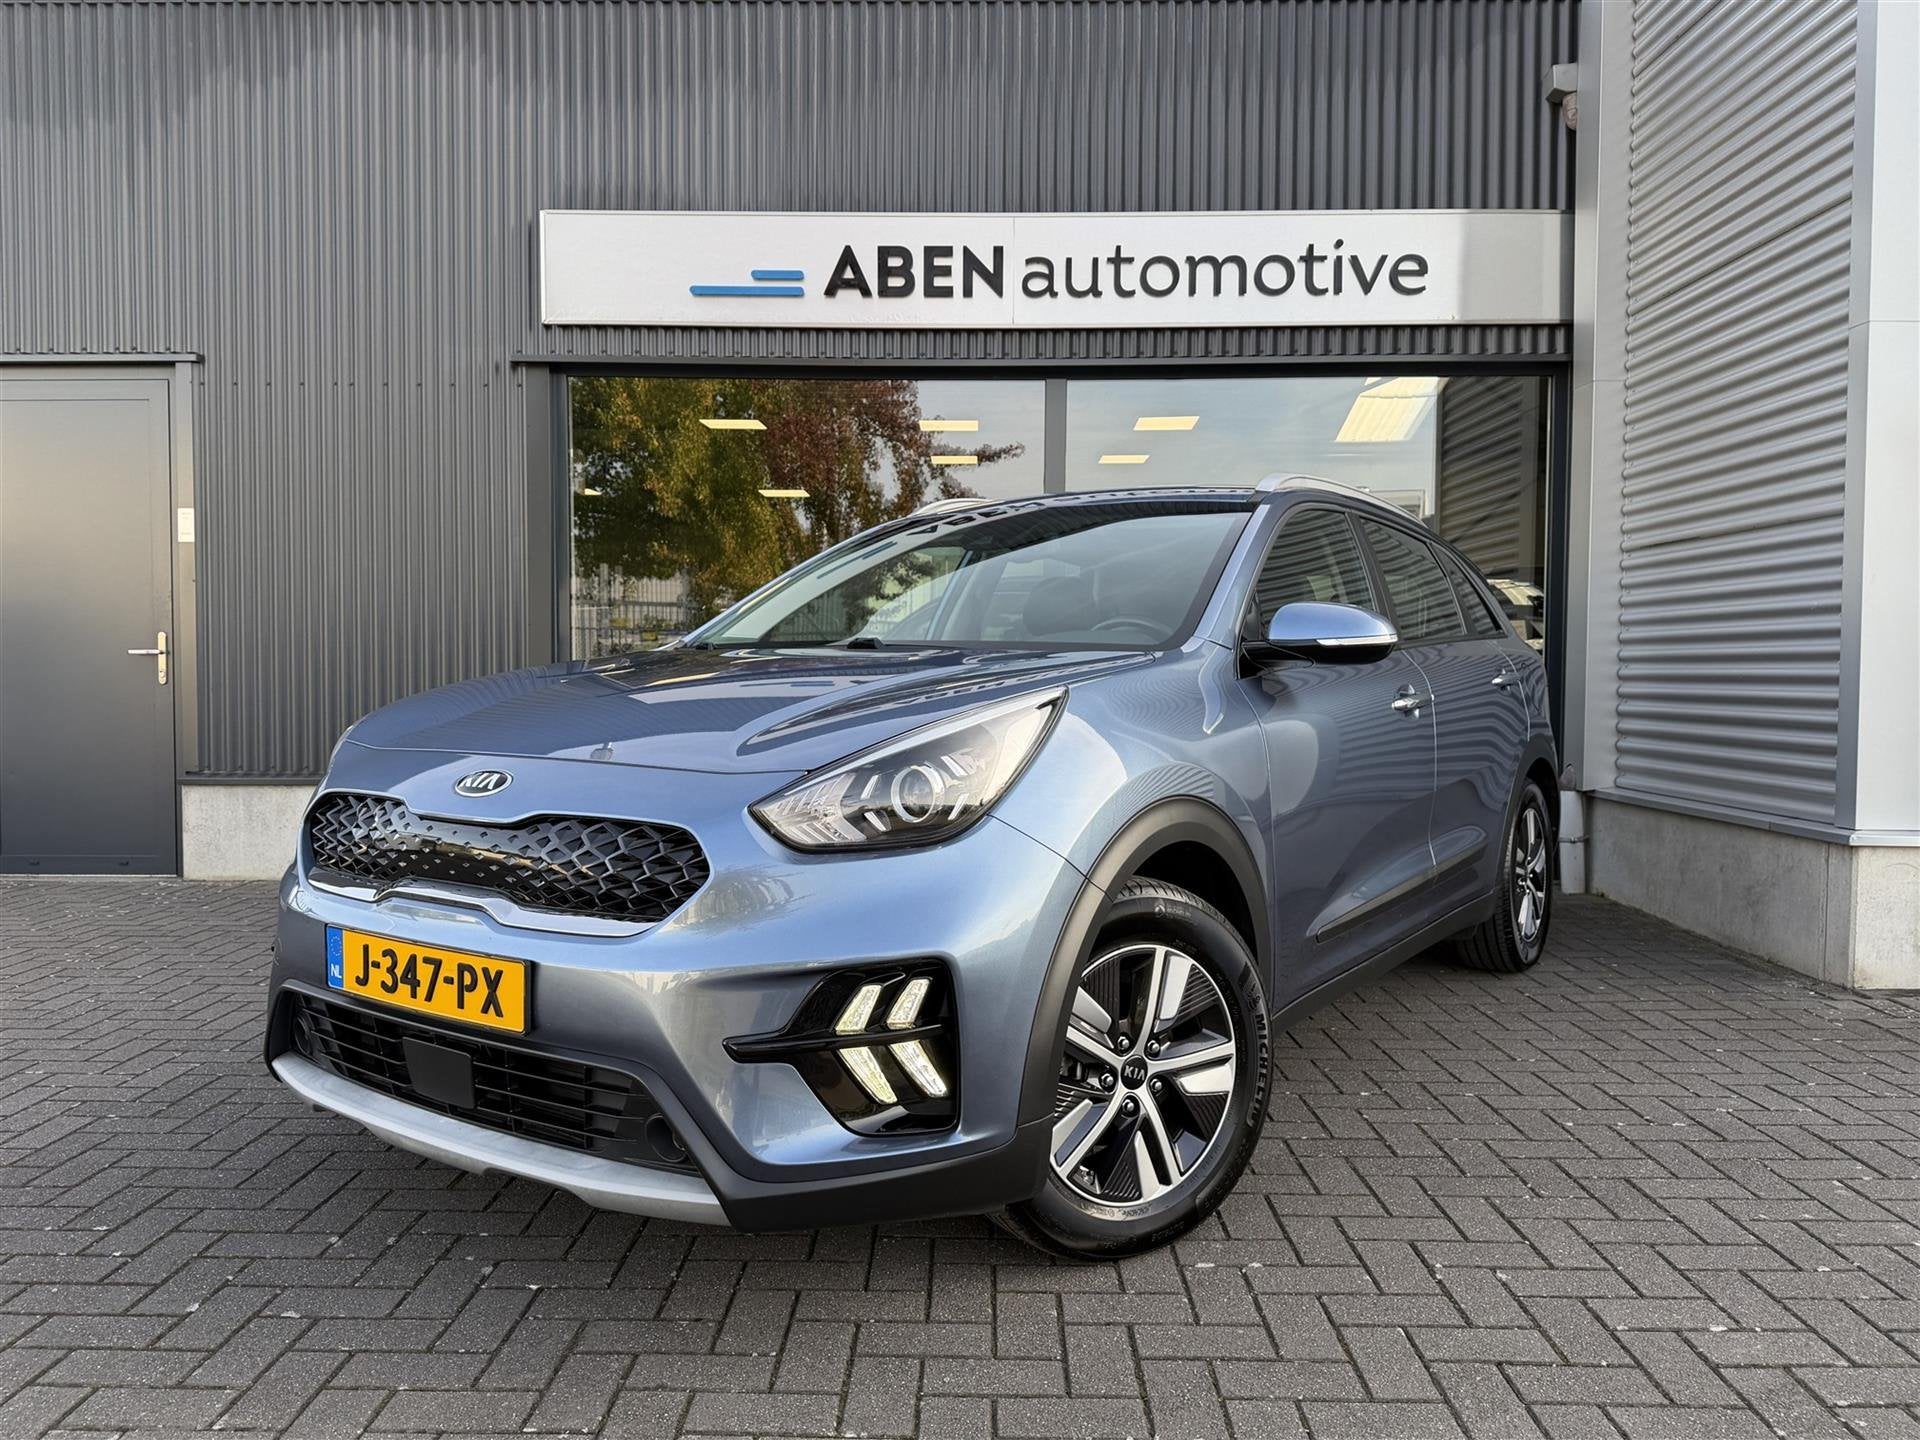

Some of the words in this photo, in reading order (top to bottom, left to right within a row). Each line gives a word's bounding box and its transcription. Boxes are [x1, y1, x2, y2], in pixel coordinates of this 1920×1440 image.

[824, 245, 1004, 298] ABEN
[1021, 238, 1429, 299] automotive
[457, 772, 501, 790] KIA
[330, 963, 342, 979] NL
[355, 943, 504, 1018] J-347-PX
[1124, 1065, 1145, 1081] KIA
